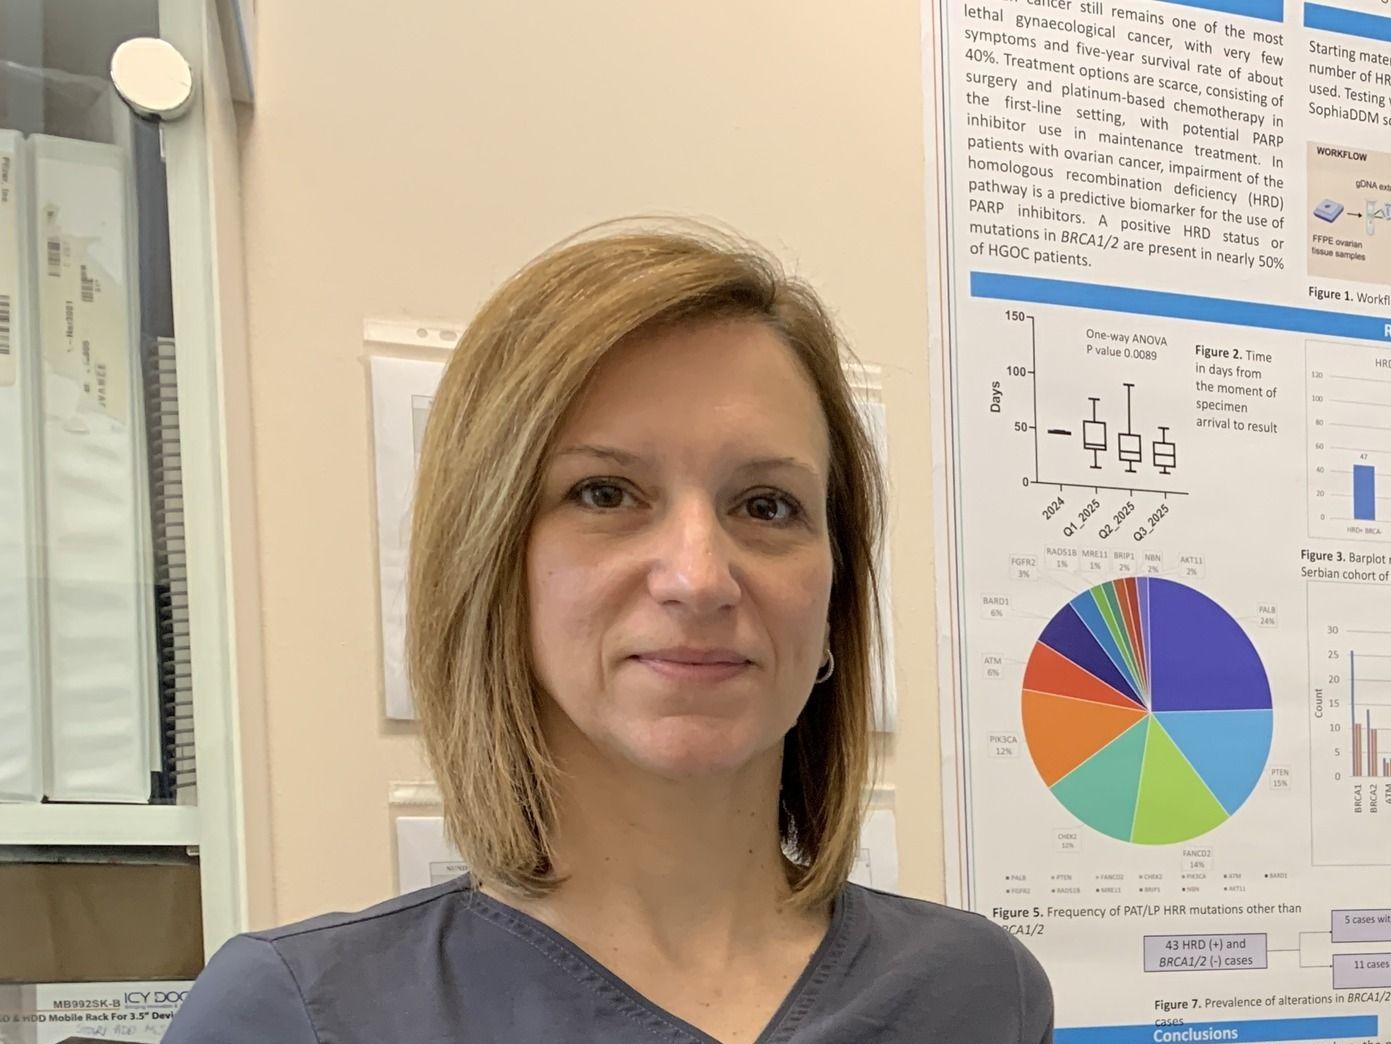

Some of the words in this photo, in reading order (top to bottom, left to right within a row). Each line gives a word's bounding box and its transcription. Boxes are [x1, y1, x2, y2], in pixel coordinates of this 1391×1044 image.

[964, 4, 1003, 22] lethal
[1015, 14, 1115, 38] gynaecological
[1127, 31, 1172, 49] cancer,
[1184, 39, 1212, 54] with
[1223, 47, 1250, 63] very
[1261, 50, 1283, 66] few
[964, 29, 1036, 48] symptoms
[1044, 40, 1068, 52] and
[1076, 42, 1135, 62] five-year
[1141, 54, 1190, 71] survival
[1197, 64, 1221, 77] rate
[1228, 67, 1241, 80] of
[1247, 70, 1283, 87] about
[1309, 40, 1356, 62] Starting
[1316, 147, 1367, 161] WORKFLOW
[969, 241, 984, 255] of
[988, 243, 1029, 260] HGOC
[1034, 250, 1091, 266] patients.
[1308, 286, 1341, 300] Figure
[1344, 290, 1353, 301] 1.
[1005, 310, 1025, 322] 150
[1086, 328, 1129, 344] One-way
[1132, 333, 1167, 346] ANOVA
[1086, 344, 1093, 353] P
[1095, 346, 1121, 357] value
[1124, 348, 1157, 360] 0.0089
[1195, 344, 1229, 358] Figure
[1232, 348, 1242, 359] 2.
[1245, 349, 1272, 363] Time
[990, 381, 1001, 413] Days
[1042, 497, 1065, 521] 2024
[1063, 500, 1101, 538] Q1_2025
[1315, 688, 1323, 718] Count
[1165, 940, 1179, 950] 43
[1182, 939, 1206, 950] HRD
[1209, 938, 1223, 951] (+)
[1226, 938, 1246, 949] and
[124, 992, 151, 1004] ICY
[49, 1013, 83, 1022] Mobile
[86, 1013, 109, 1022] Rack
[111, 1012, 127, 1021] For
[1153, 1027, 1238, 1042] Conclusions
